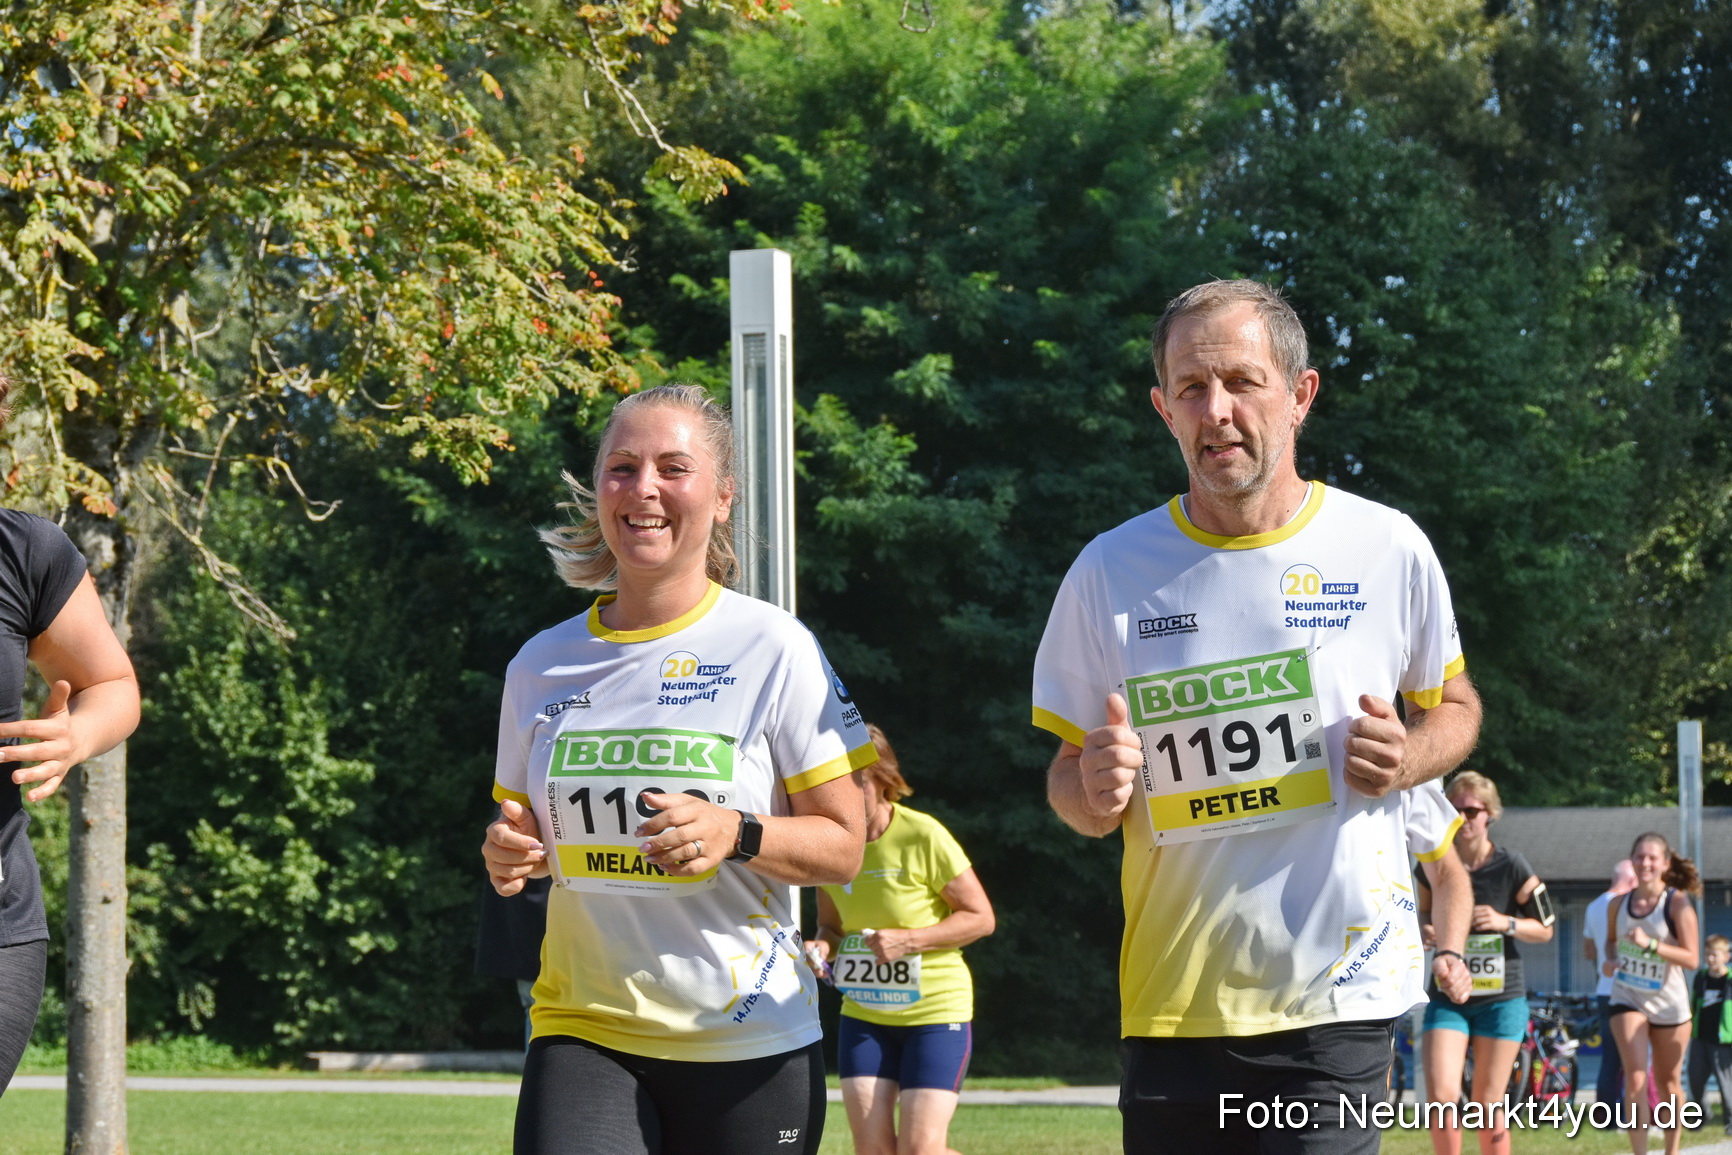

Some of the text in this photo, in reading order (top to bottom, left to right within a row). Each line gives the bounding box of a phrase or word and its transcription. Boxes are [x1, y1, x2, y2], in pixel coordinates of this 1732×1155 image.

[1285, 573, 1357, 595] 20 JAHRE
[1284, 599, 1367, 611] Neumarkter
[1138, 613, 1198, 634] BOCK
[1284, 615, 1352, 630] Stadtlauf
[663, 658, 697, 678] 20
[1136, 657, 1299, 719] BOCK
[1303, 713, 1312, 723] D
[562, 734, 720, 774] BOCK
[1156, 713, 1297, 782] 1191
[717, 795, 726, 804] D
[1189, 786, 1281, 819] PETER
[843, 959, 910, 985] 2208
[1620, 957, 1658, 978] 2111
[846, 989, 912, 1003] GERLINDE
[733, 993, 760, 1024] 14./15.
[779, 1128, 799, 1138] TAO
